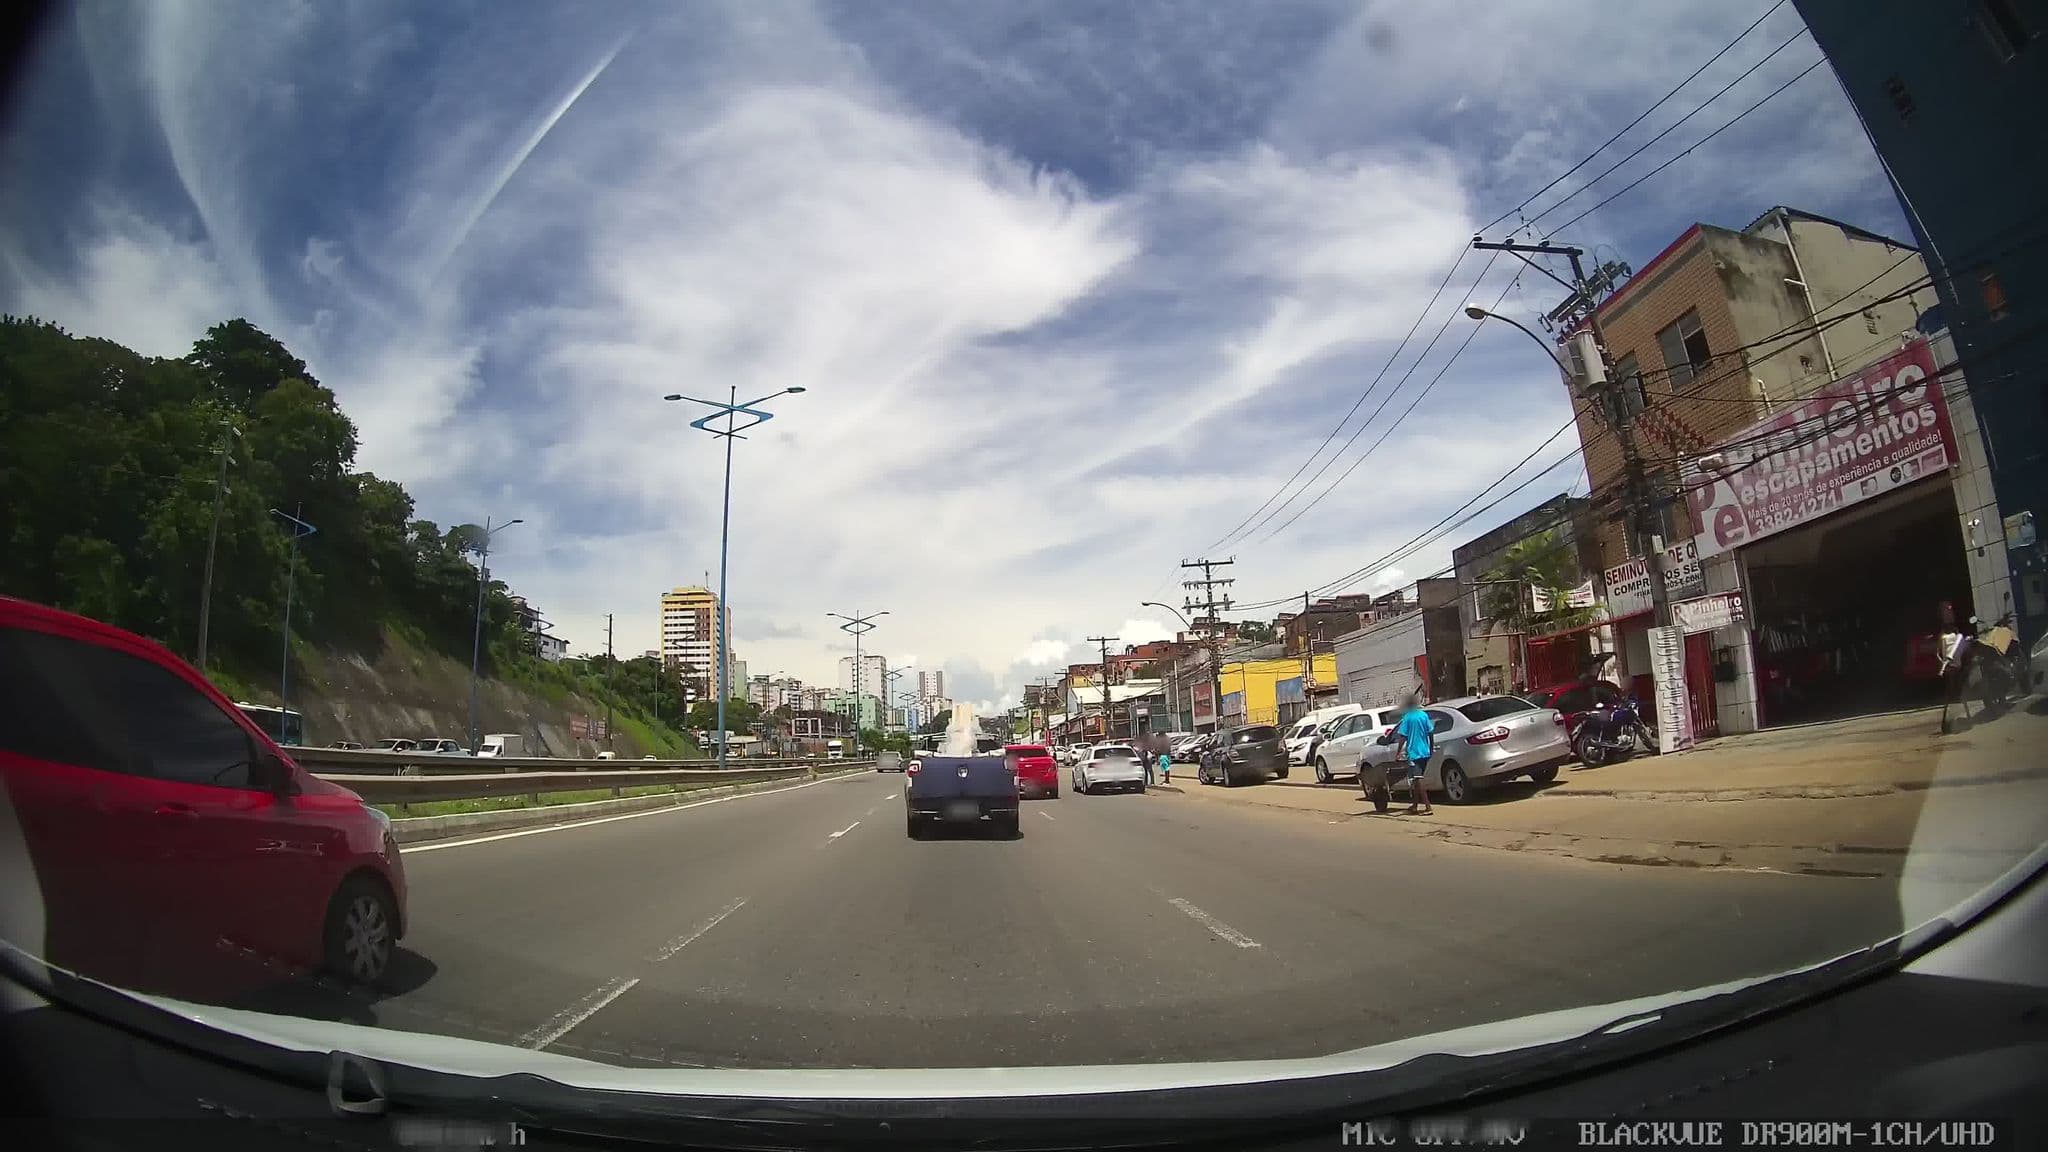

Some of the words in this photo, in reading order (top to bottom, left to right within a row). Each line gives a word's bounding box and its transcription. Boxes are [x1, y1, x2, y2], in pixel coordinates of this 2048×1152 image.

[1740, 403, 1937, 505] escapamentos
[1748, 507, 1768, 520] Mais
[1769, 501, 1779, 512] de
[1782, 496, 1791, 508] 20
[1816, 481, 1827, 493] de
[1829, 455, 1882, 488] experiência
[1891, 429, 1943, 463] qualidade!
